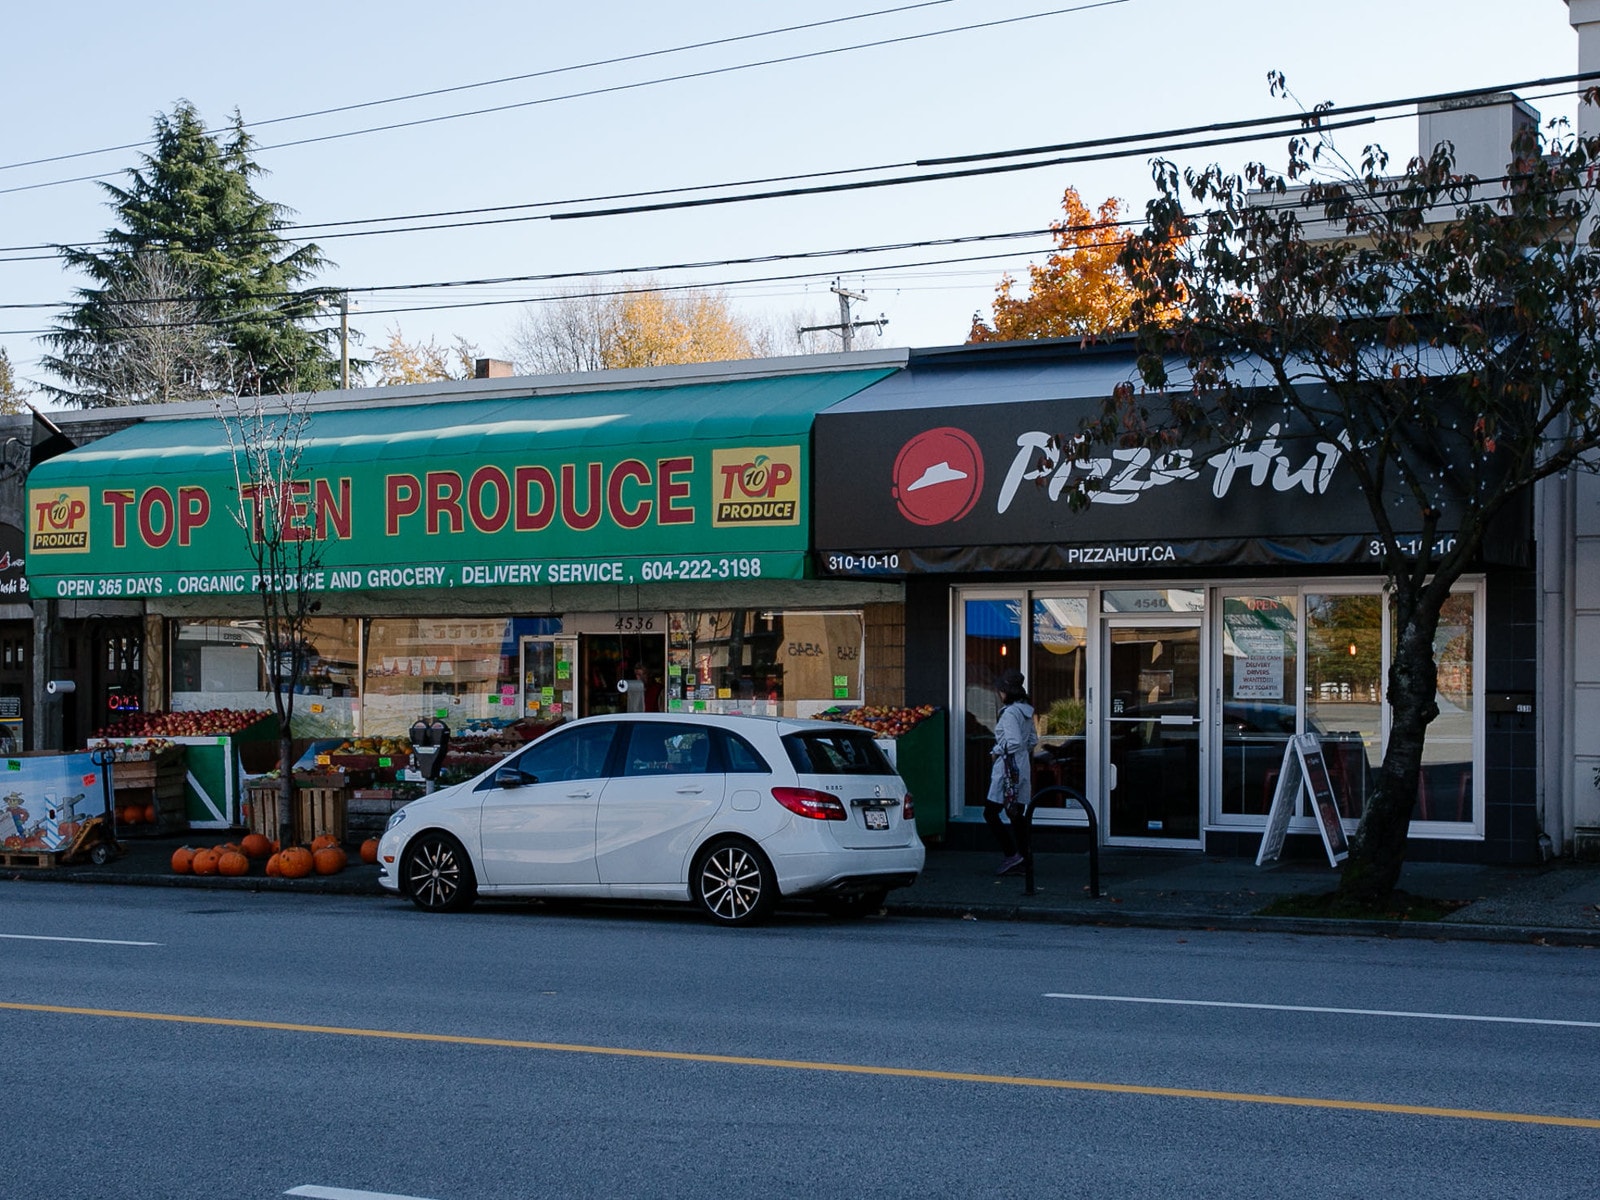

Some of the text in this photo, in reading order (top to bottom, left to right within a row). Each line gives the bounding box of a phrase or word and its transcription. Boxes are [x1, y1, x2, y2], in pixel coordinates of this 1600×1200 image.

[720, 462, 792, 499] TOP
[745, 470, 766, 487] 10
[103, 456, 695, 549] TOP TEN PRODUCE
[721, 503, 793, 519] PRODUCE
[36, 500, 86, 531] TOP
[53, 506, 67, 520] 10
[35, 533, 85, 547] PRODUCE
[828, 553, 899, 571] 310-10-10
[1068, 545, 1176, 564] PIZZAHUT.CA
[57, 558, 762, 596] OPEN 365 DAYS ORGANIC PRODUCE AND GROCERY DELIVERY SERVICE 604-222-3198
[1134, 598, 1168, 609] 4540
[1246, 598, 1279, 611] OPEN
[614, 616, 654, 630] 4536
